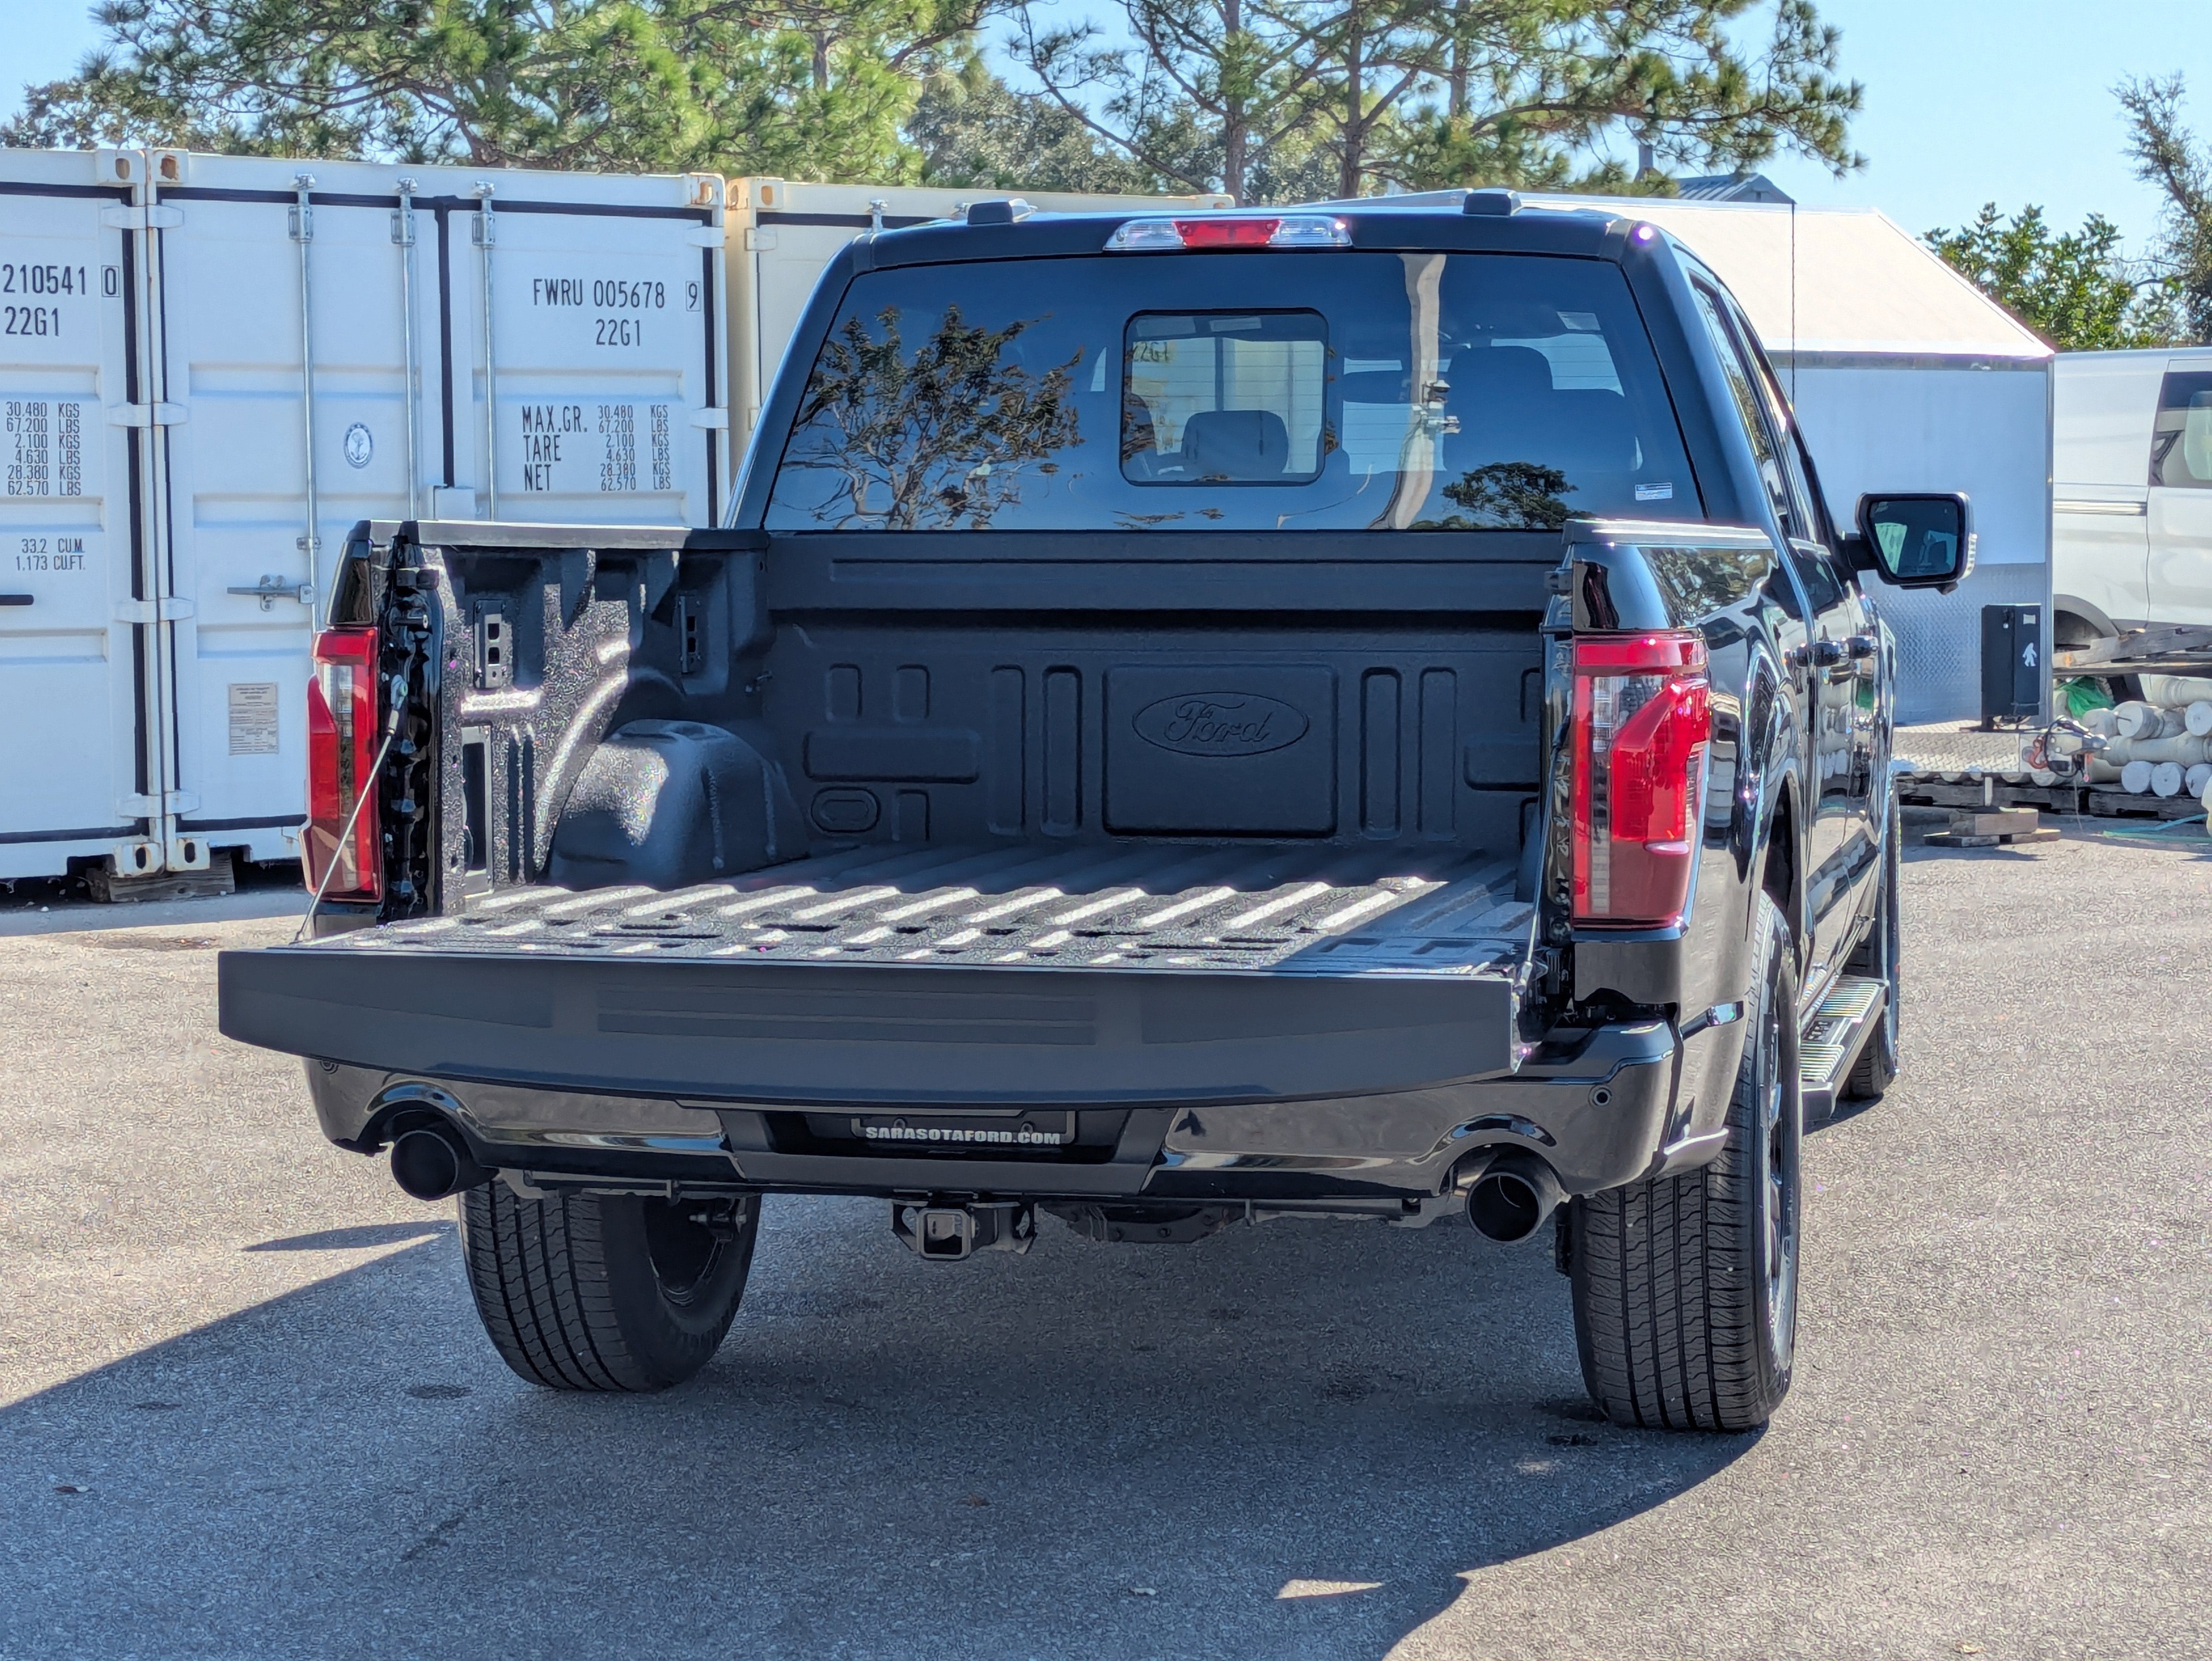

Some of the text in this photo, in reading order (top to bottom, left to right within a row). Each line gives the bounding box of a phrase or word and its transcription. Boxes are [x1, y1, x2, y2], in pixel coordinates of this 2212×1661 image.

[2, 264, 117, 295] 210541 0
[533, 278, 698, 309] FWRU 005678 9
[5, 306, 59, 336] 22G1
[595, 319, 641, 346] 22G1
[6, 401, 79, 418] 30.480 KGS
[598, 405, 668, 419] 30.480 KGS
[7, 417, 80, 433] 67.200 LBS
[522, 405, 588, 433] MAX.GR.
[599, 419, 669, 433] 67.200 LBS
[15, 433, 80, 449] 2.100 KGS
[523, 435, 562, 462] TARE
[606, 433, 669, 448] 2.100 KGS
[15, 449, 80, 465] 4.630 LBS
[606, 448, 670, 462] 4.630 LBS
[7, 465, 81, 480] 28.380 KGS
[600, 462, 671, 477] 28.380 KGS
[524, 464, 552, 492] NET
[601, 476, 671, 491] 62.570 LBS
[8, 480, 81, 496] 62.570 LBS
[16, 555, 48, 571] 1.173
[1164, 700, 1274, 742] Ford
[865, 1127, 1060, 1145] SARASOTAFORD.COM
